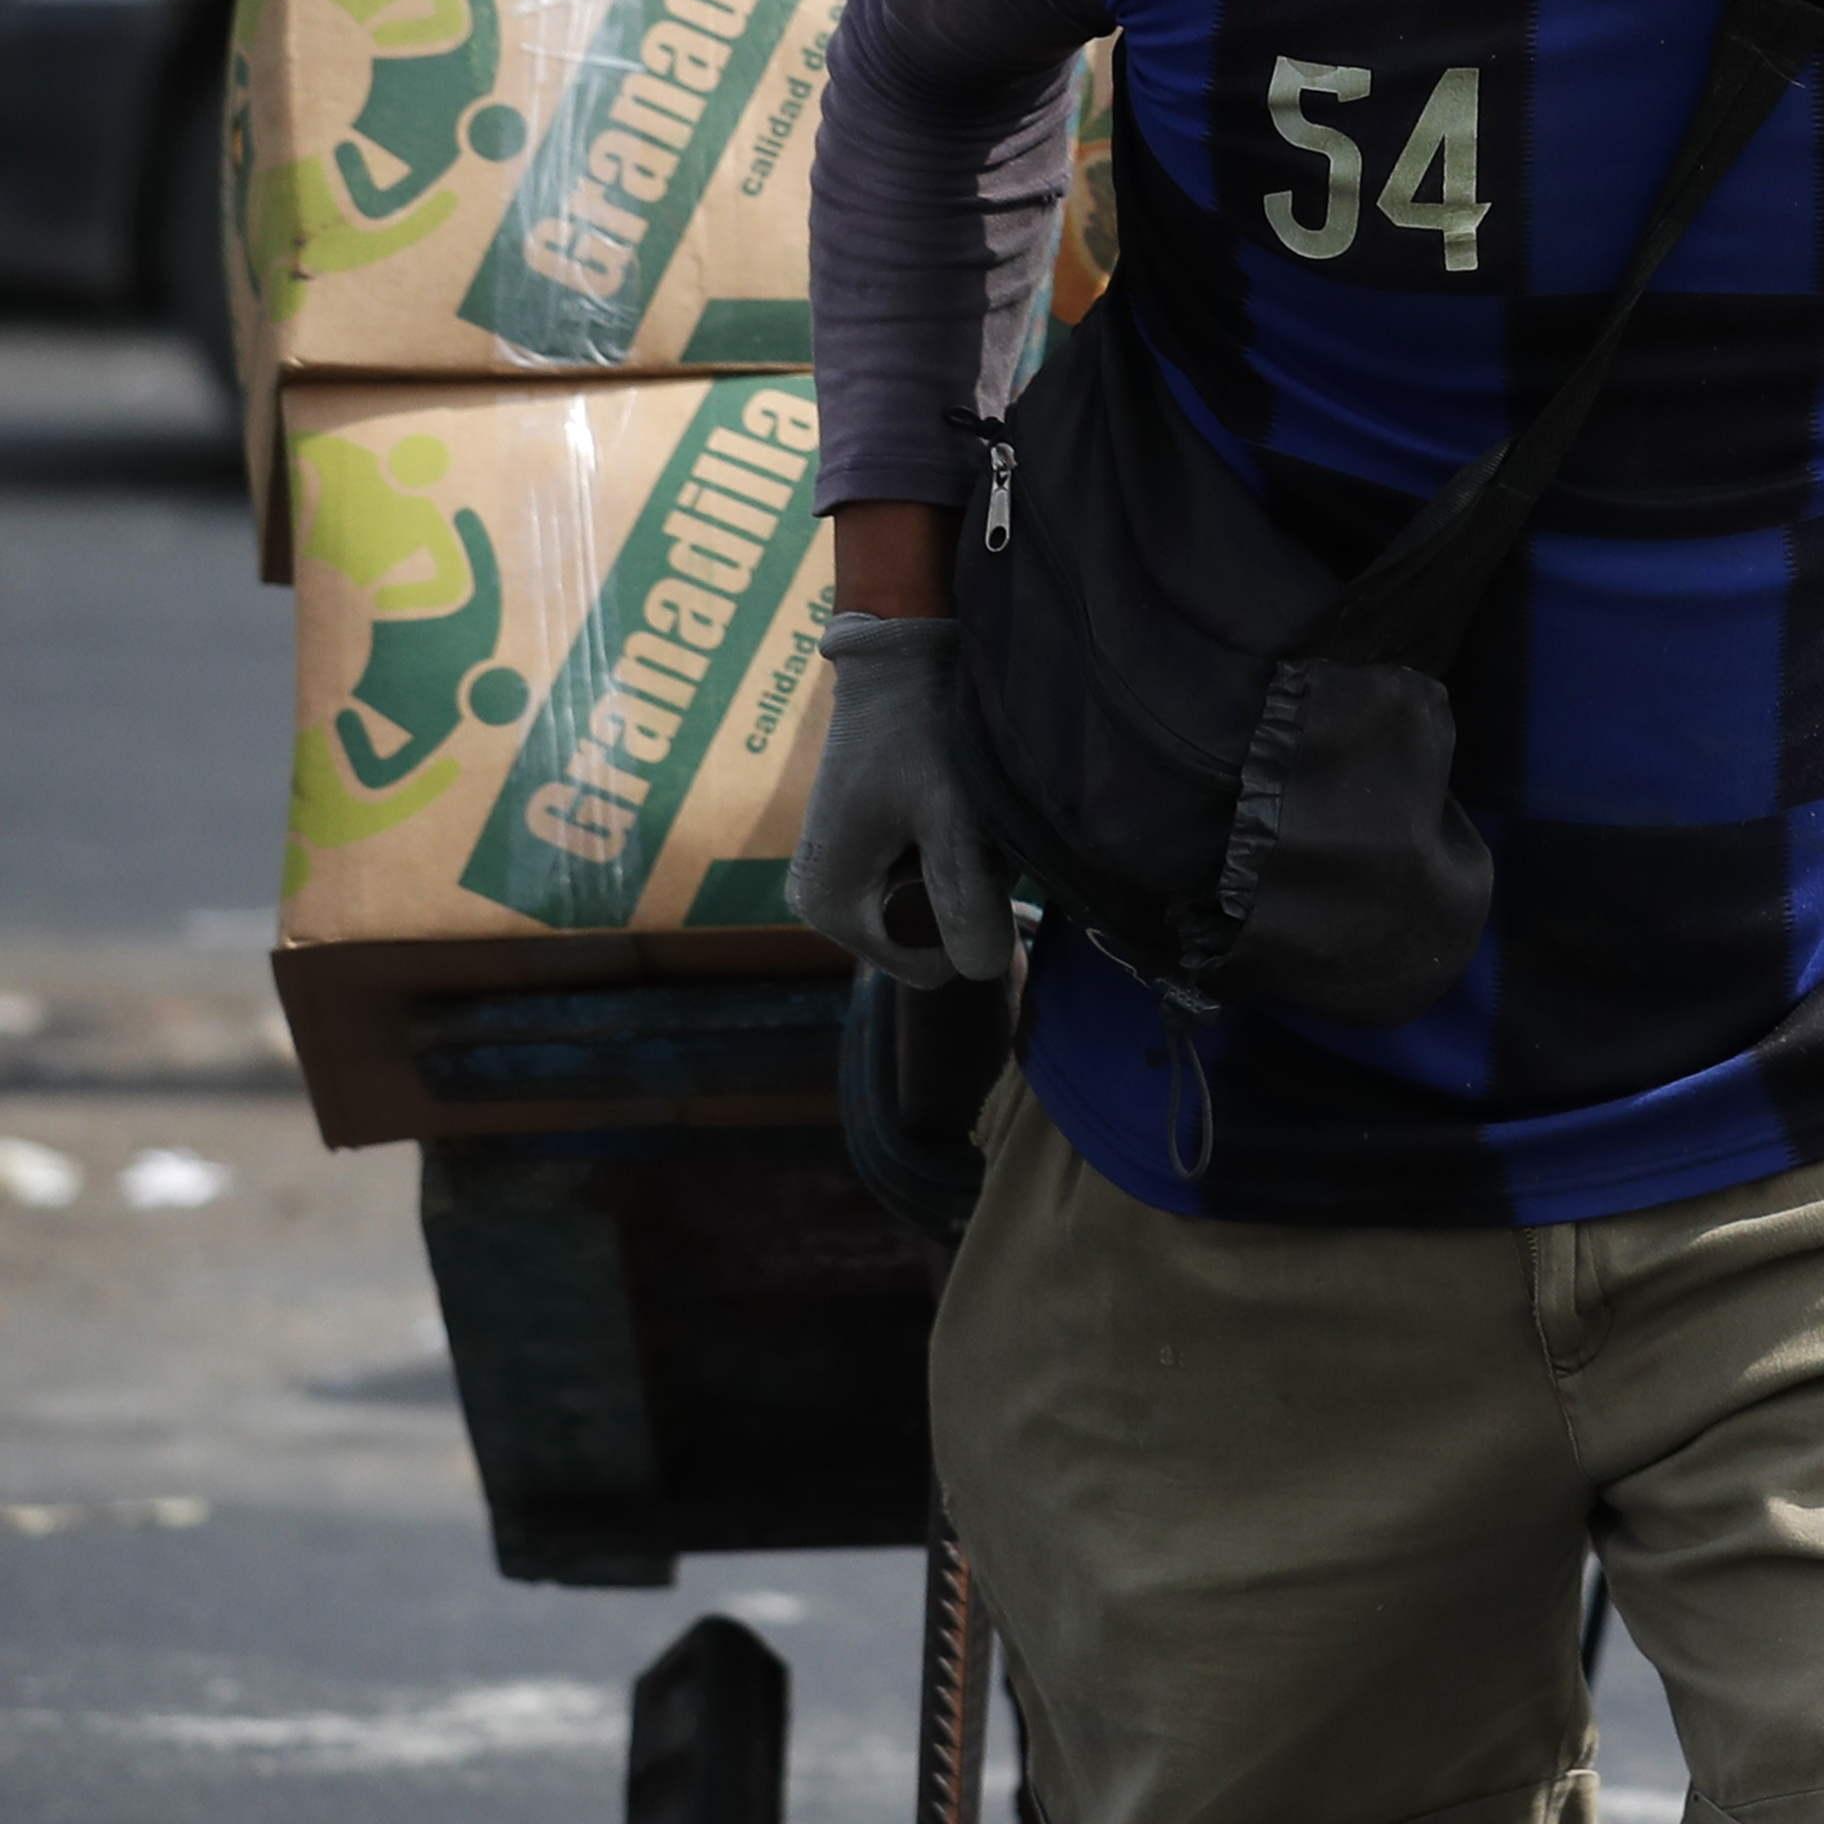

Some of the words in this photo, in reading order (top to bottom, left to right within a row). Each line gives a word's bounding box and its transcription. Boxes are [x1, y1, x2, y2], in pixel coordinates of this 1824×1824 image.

[741, 75, 812, 197] calidad
[1263, 55, 1493, 272] 54
[525, 386, 819, 863] Granadilla
[747, 629, 816, 755] calidad
